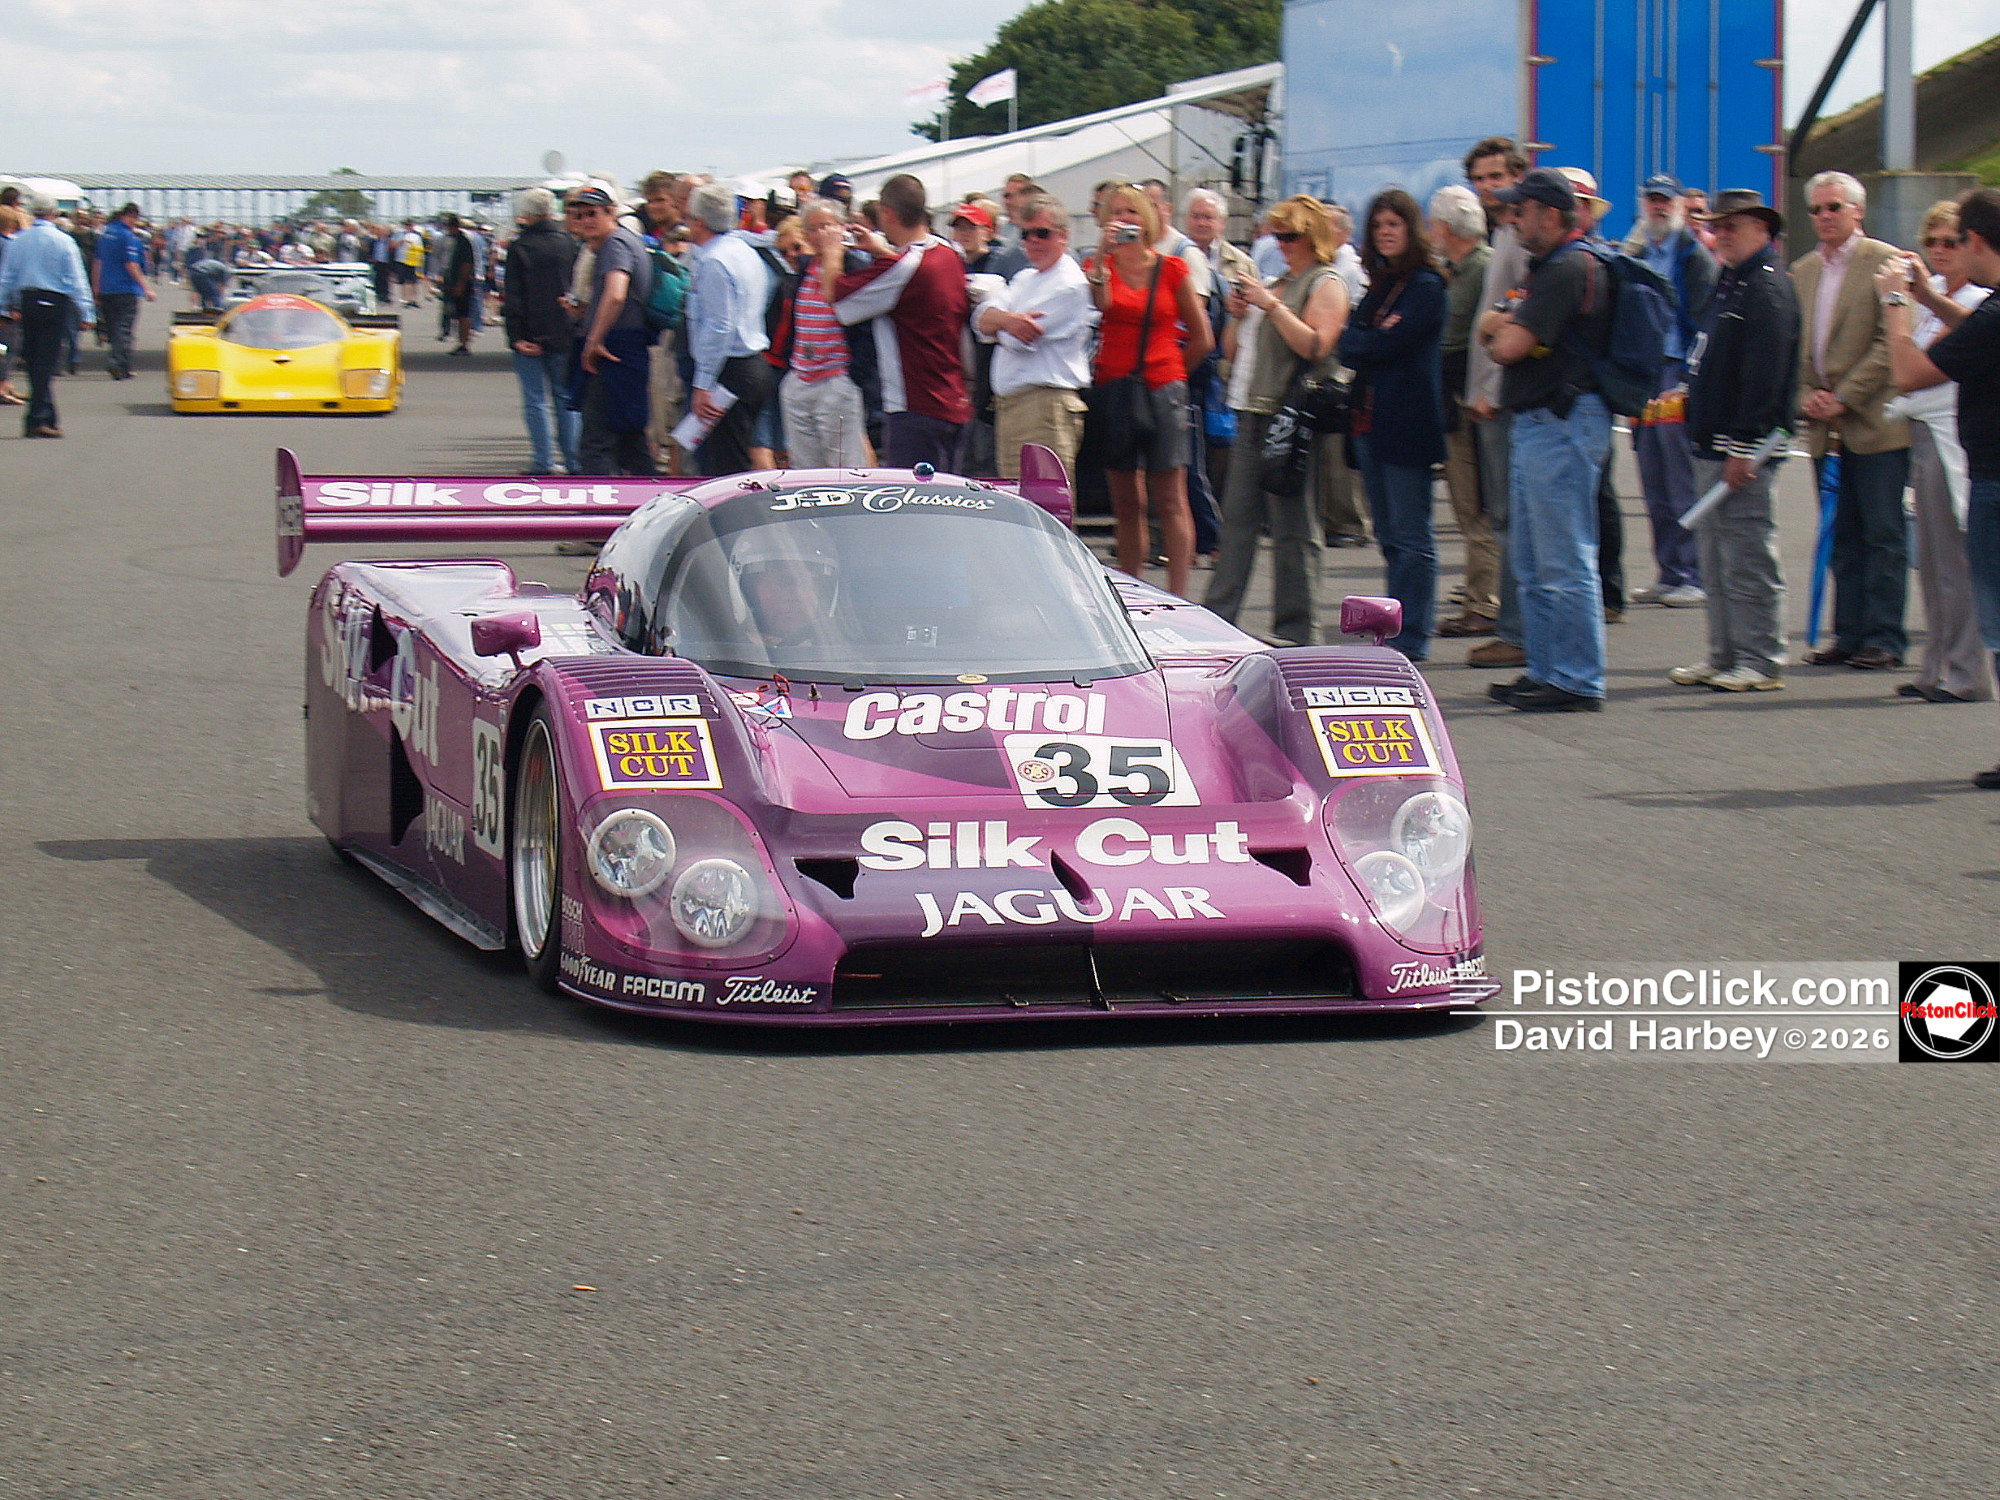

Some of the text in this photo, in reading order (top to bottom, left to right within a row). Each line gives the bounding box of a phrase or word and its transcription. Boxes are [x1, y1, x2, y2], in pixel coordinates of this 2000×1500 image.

[316, 482, 619, 507] Silk Cut
[862, 486, 996, 512] Classics
[592, 697, 695, 715] NCR
[1311, 691, 1408, 703] NCR
[843, 686, 1108, 740] Castrol
[608, 731, 697, 755] SILK
[1328, 719, 1415, 742] SILK
[619, 754, 694, 777] CUT
[1342, 741, 1414, 764] CUT
[1033, 742, 1170, 807] 35
[475, 731, 501, 845] 35
[856, 817, 1251, 871] Silk Cut
[914, 886, 1227, 938] JAGUAR
[623, 974, 706, 1003] FACOM
[716, 976, 818, 1006] Titleist
